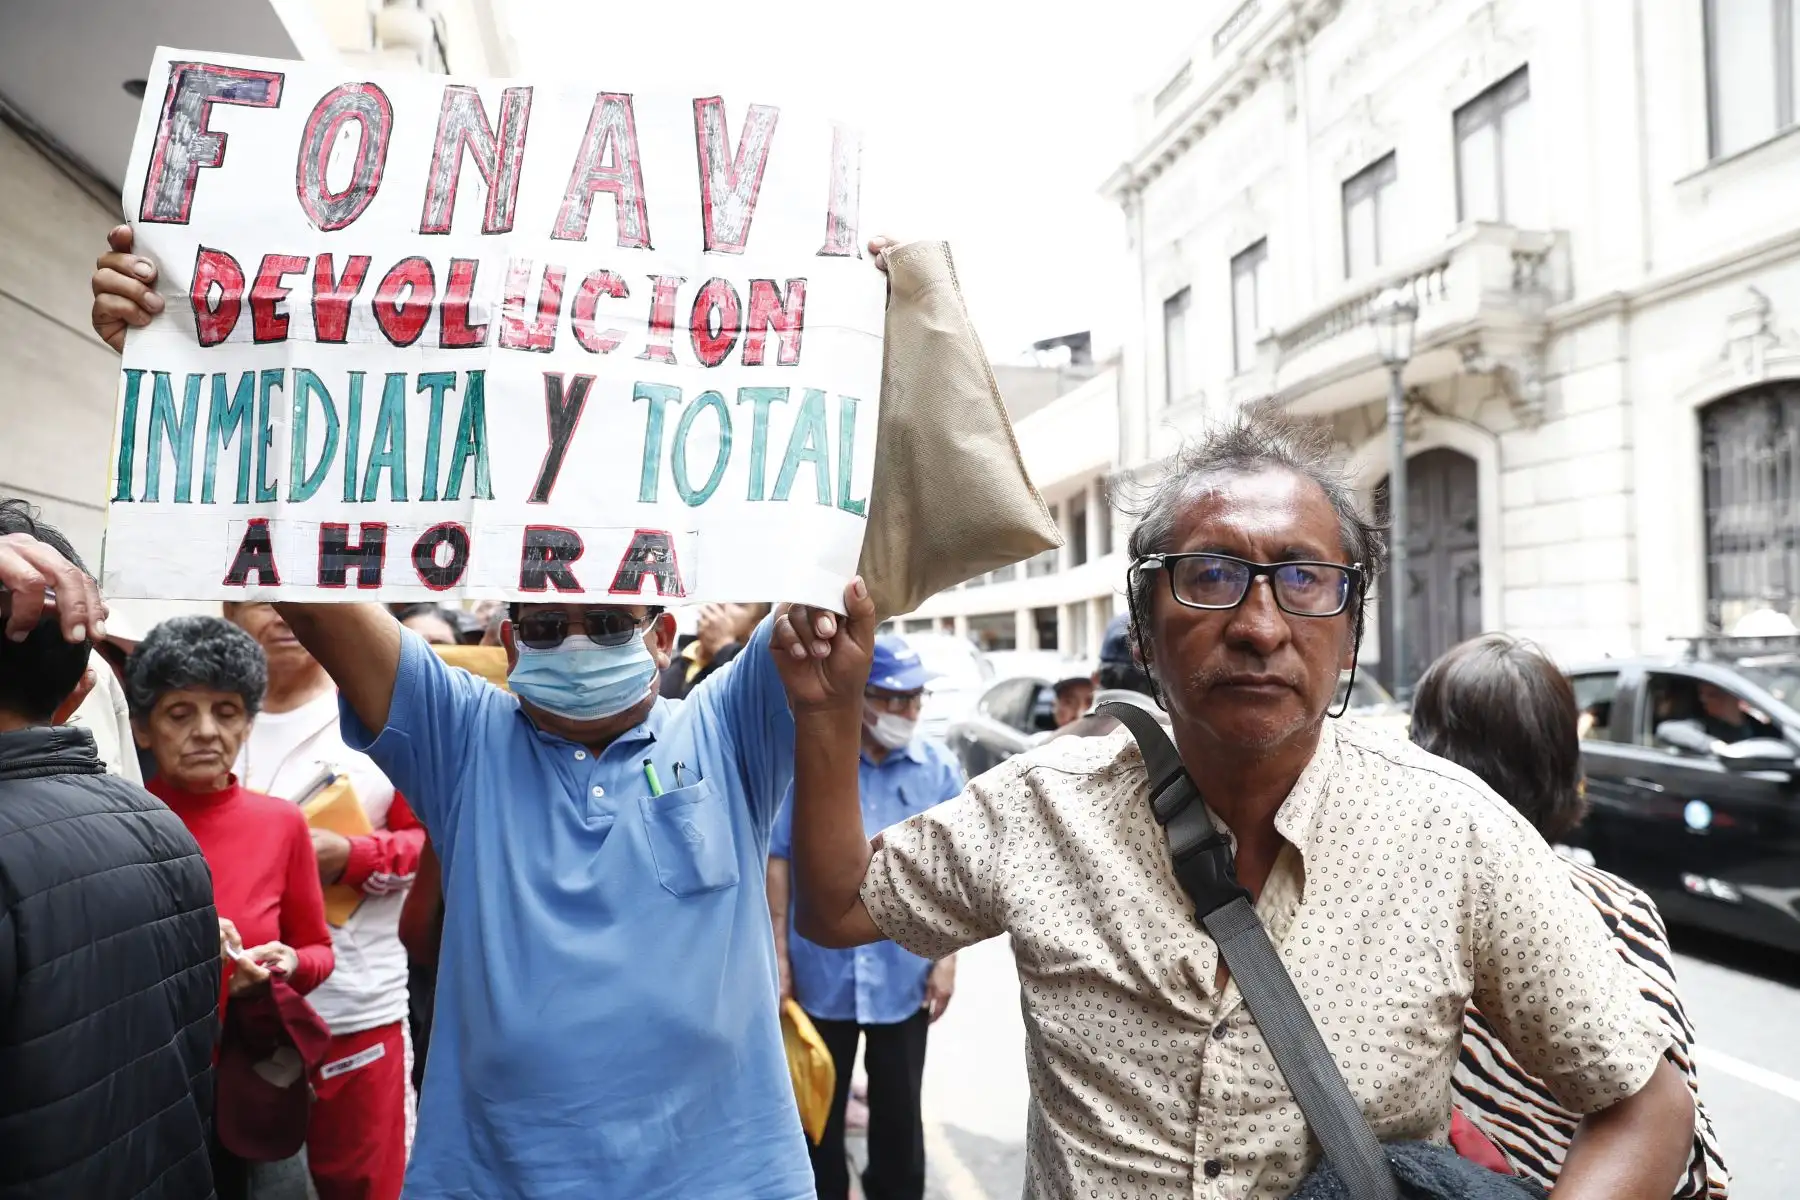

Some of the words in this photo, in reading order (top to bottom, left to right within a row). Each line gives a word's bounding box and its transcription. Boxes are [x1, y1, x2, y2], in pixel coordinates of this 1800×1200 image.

[139, 60, 864, 258] FONAVI
[190, 245, 807, 367] DEVOLUCION
[111, 368, 496, 504] INMEDIATA
[526, 372, 597, 505] Y
[632, 381, 867, 518] TOTAL
[224, 518, 686, 598] AHORA
